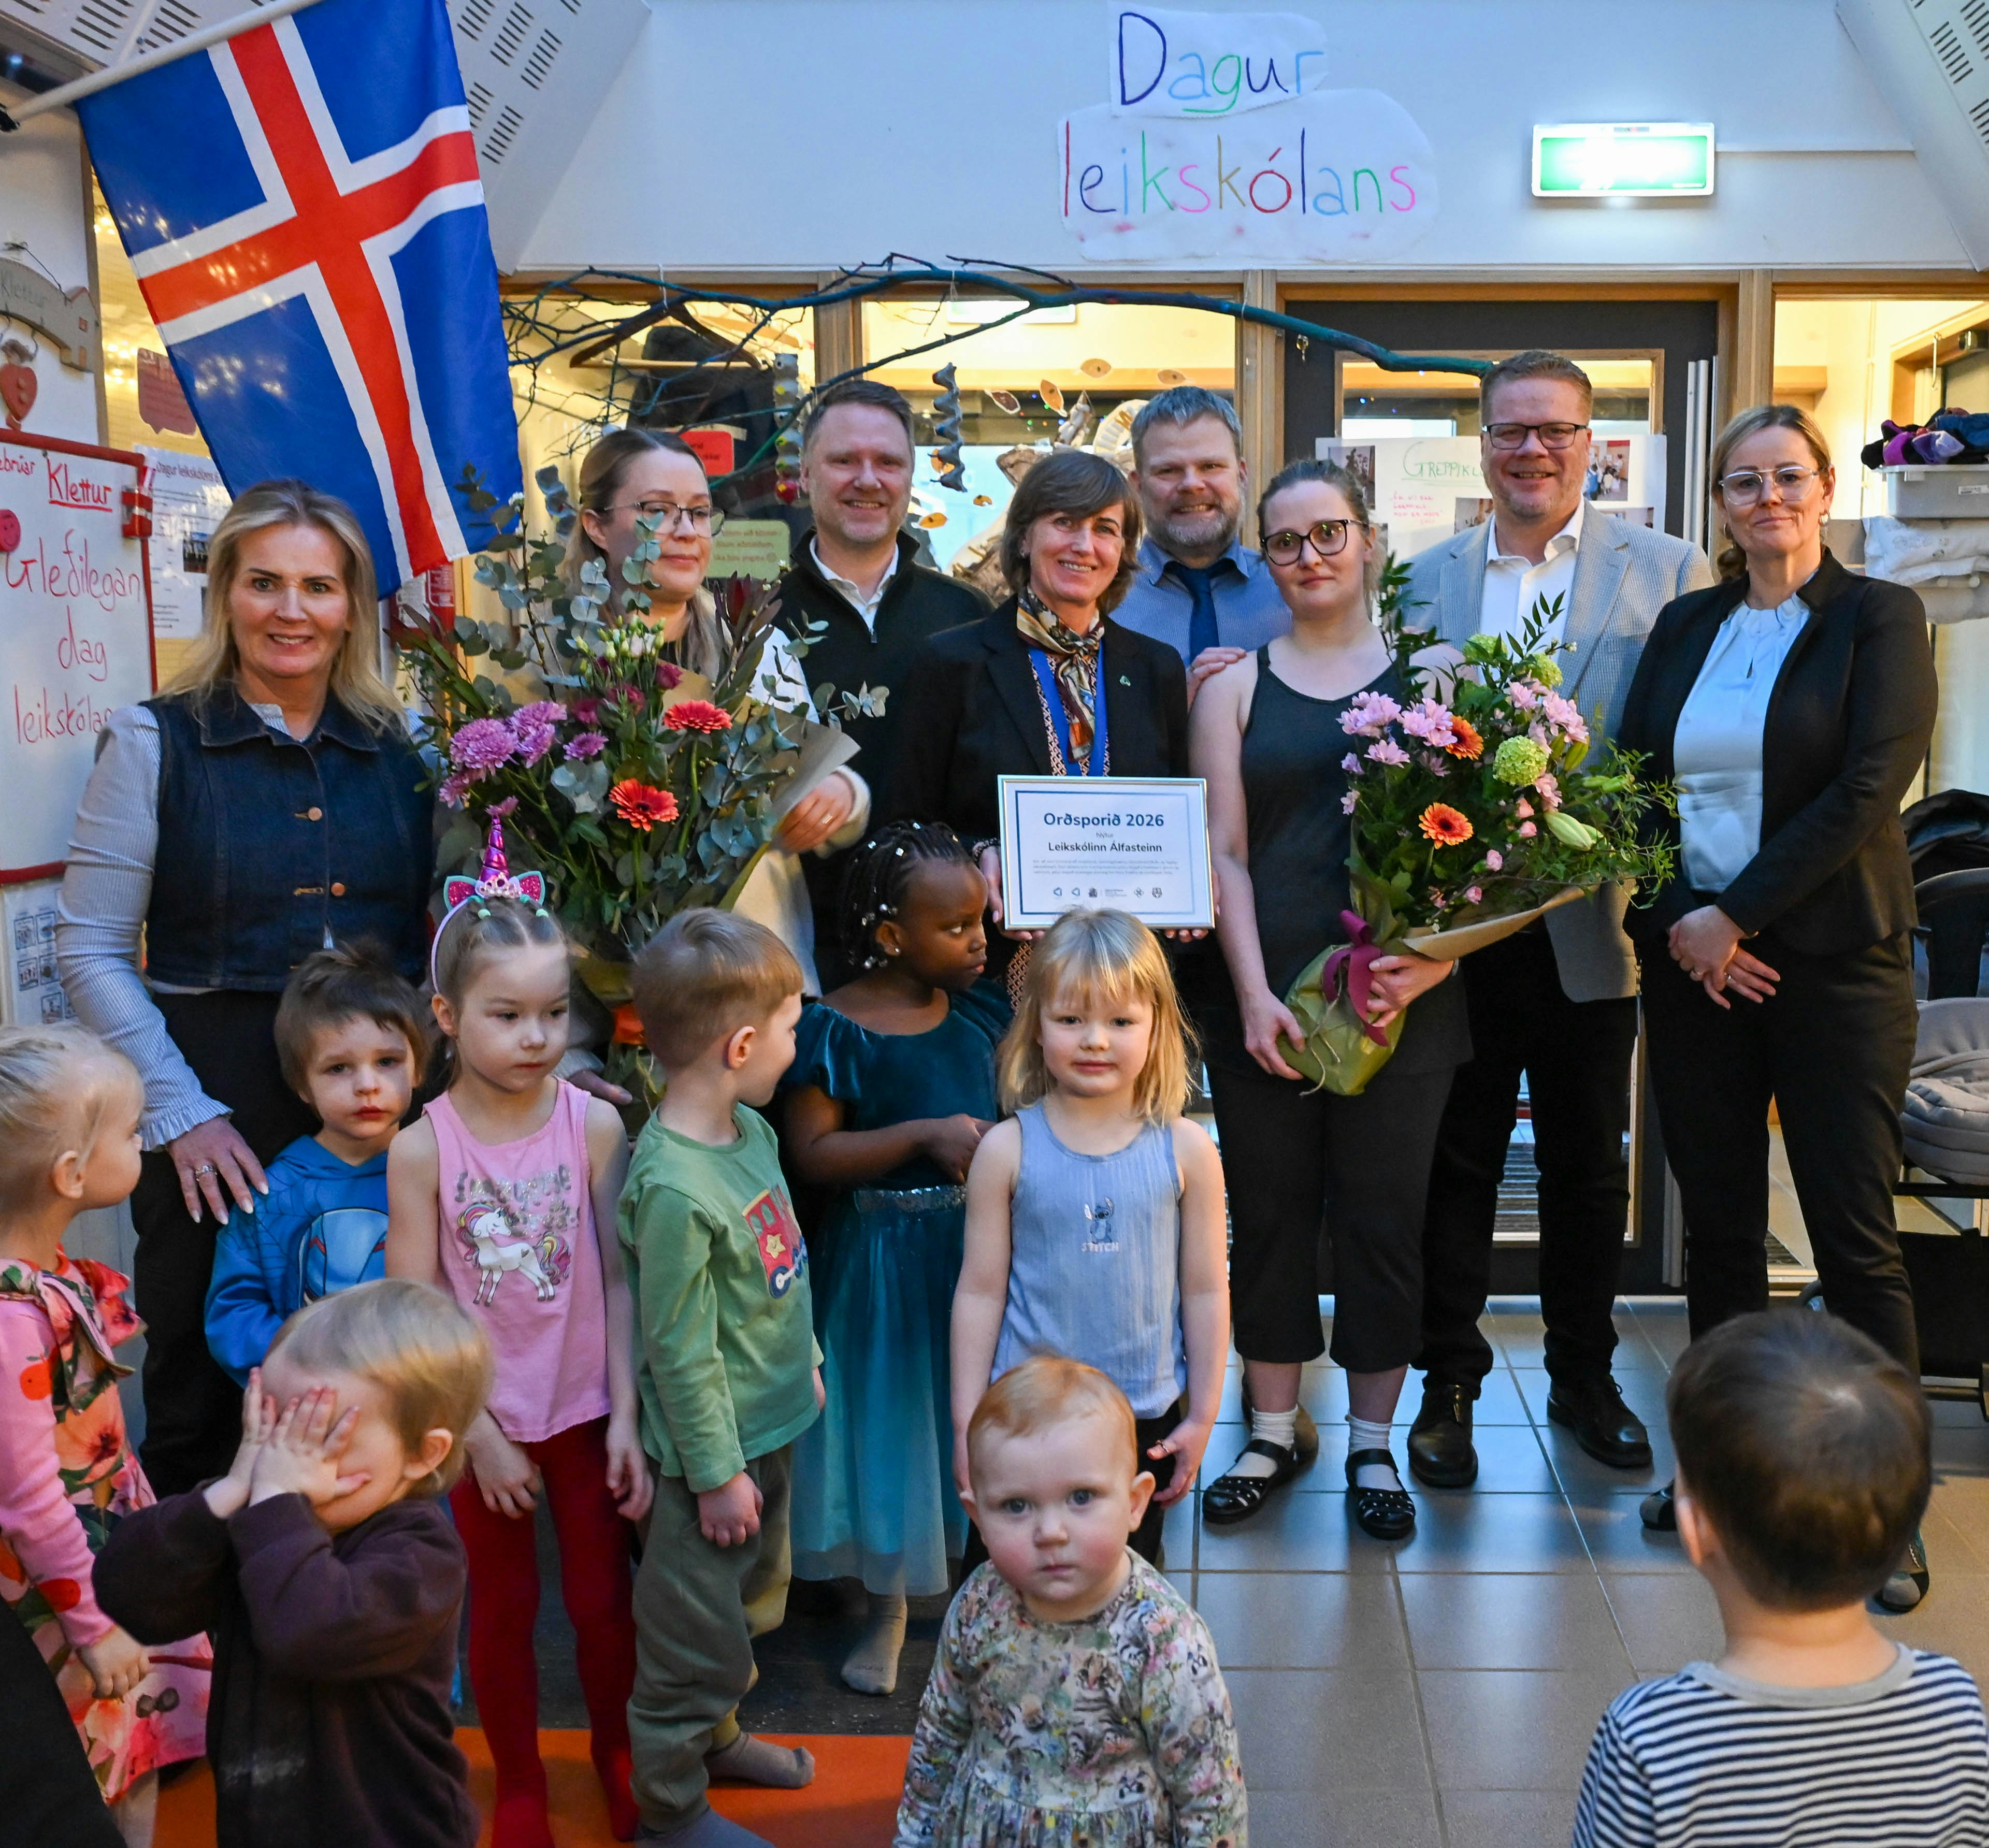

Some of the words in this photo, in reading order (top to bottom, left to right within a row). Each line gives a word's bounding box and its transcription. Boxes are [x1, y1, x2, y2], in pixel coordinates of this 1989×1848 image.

[1118, 12, 1324, 113] Dagur
[1064, 121, 1416, 217] leikskólans
[47, 456, 112, 505] Klettur
[1403, 440, 1484, 478] GREPPIKL
[58, 605, 108, 682] dag
[1044, 813, 1121, 828] Orðsporið
[1126, 814, 1164, 827] 2026
[1048, 841, 1107, 853] Leikskólinn
[1110, 840, 1162, 852] Álfasteinn
